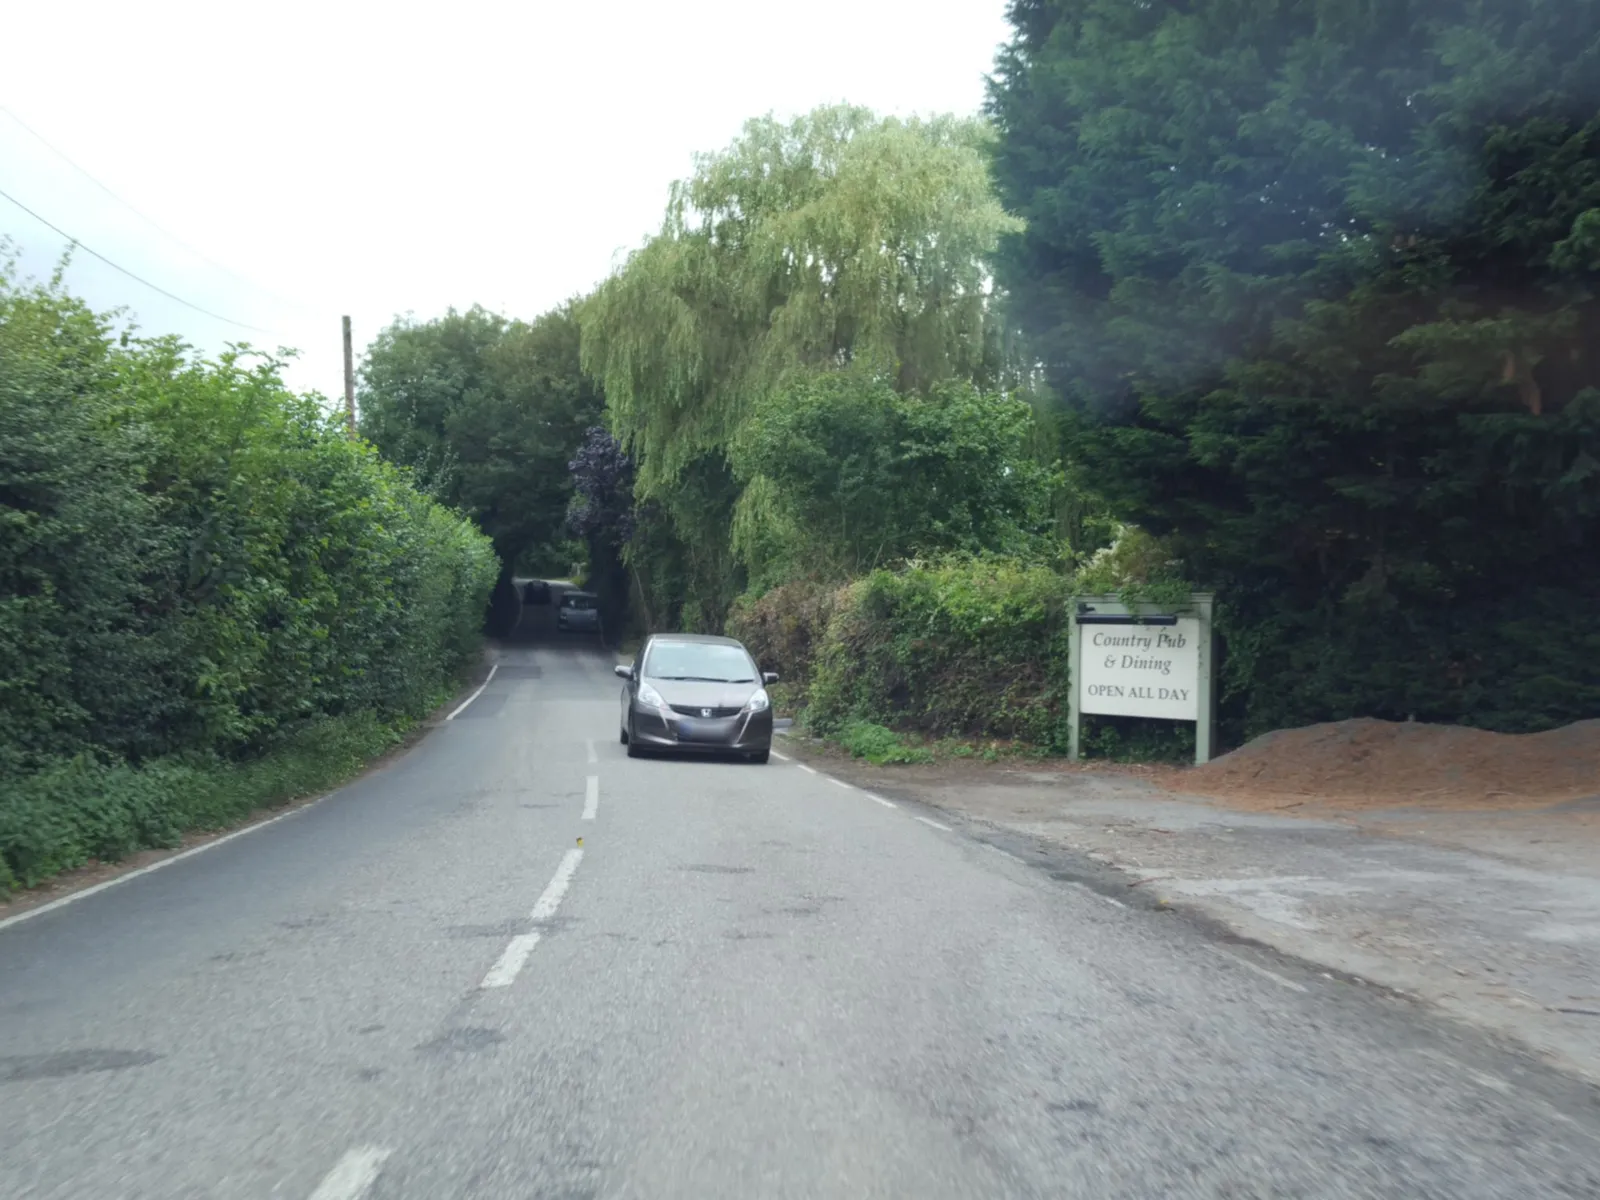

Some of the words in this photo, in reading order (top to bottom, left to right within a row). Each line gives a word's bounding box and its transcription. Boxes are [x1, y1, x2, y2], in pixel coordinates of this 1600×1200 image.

[1093, 632, 1151, 652] Country
[1157, 633, 1187, 648] Pub
[1104, 654, 1116, 669] &
[1121, 655, 1172, 675] Dining
[1088, 684, 1125, 697] OPEN
[1128, 687, 1154, 699] ALL
[1158, 688, 1189, 701] DAY
